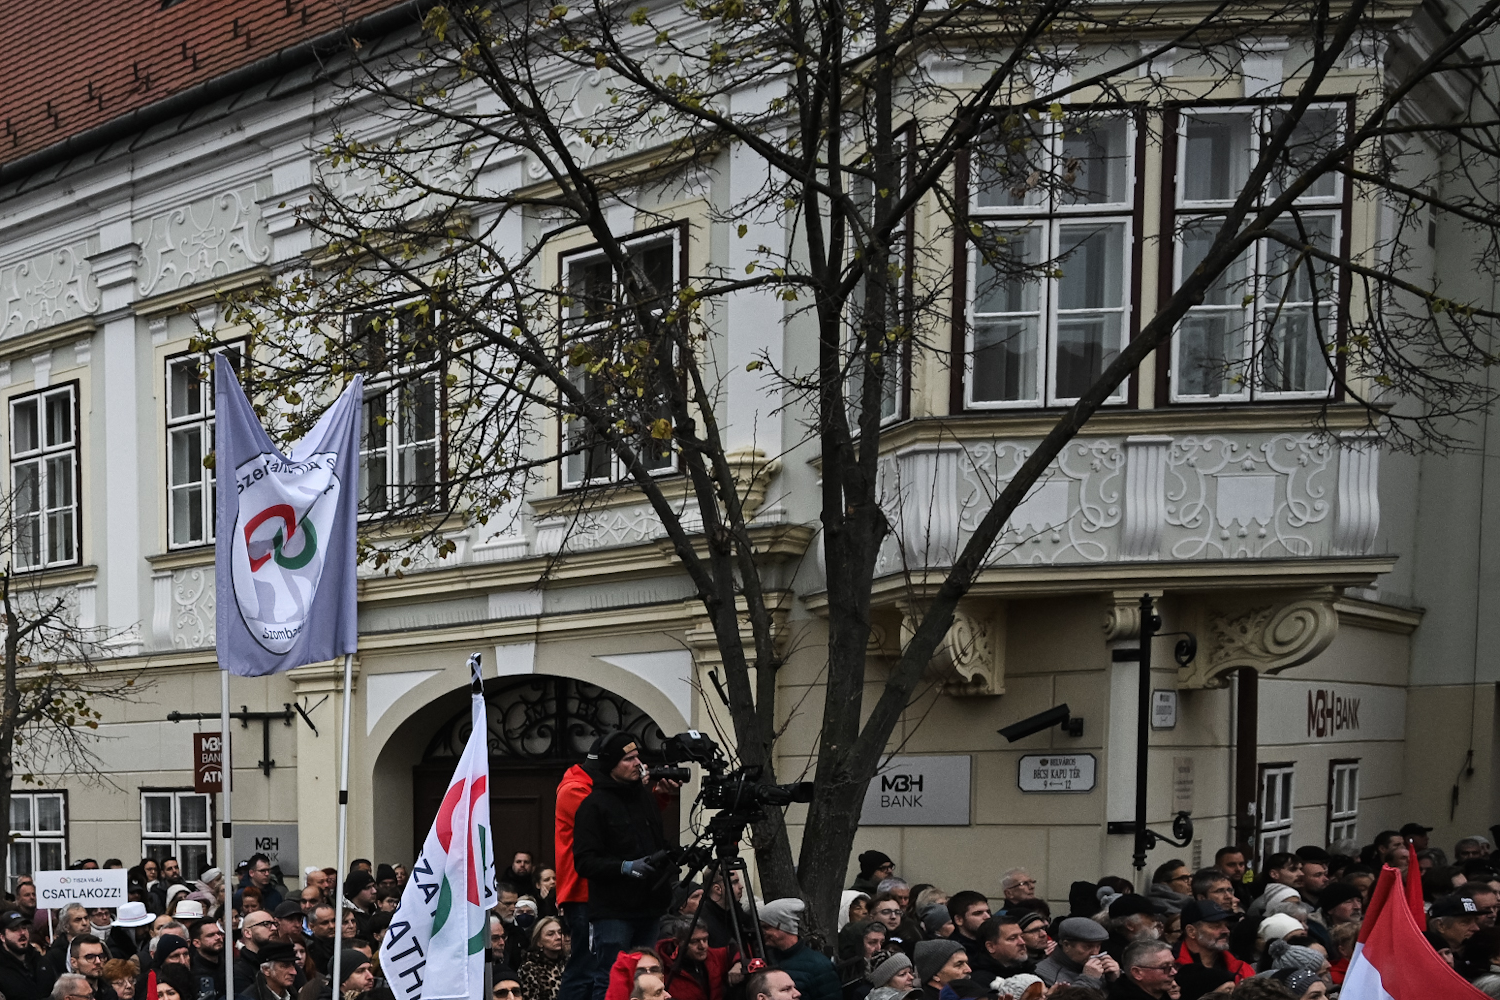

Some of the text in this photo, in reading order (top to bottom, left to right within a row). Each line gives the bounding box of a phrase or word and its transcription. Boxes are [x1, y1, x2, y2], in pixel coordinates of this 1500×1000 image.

[1308, 690, 1361, 738] MBH BANK
[201, 753, 222, 763] BAN
[1034, 766, 1081, 779] BÉCSI KAPU TÉR
[881, 775, 923, 792] MBH
[1065, 780, 1071, 789] 12
[881, 795, 923, 808] BANK
[255, 837, 279, 850] MBH
[42, 887, 121, 899] CSATLAKOZZ!
